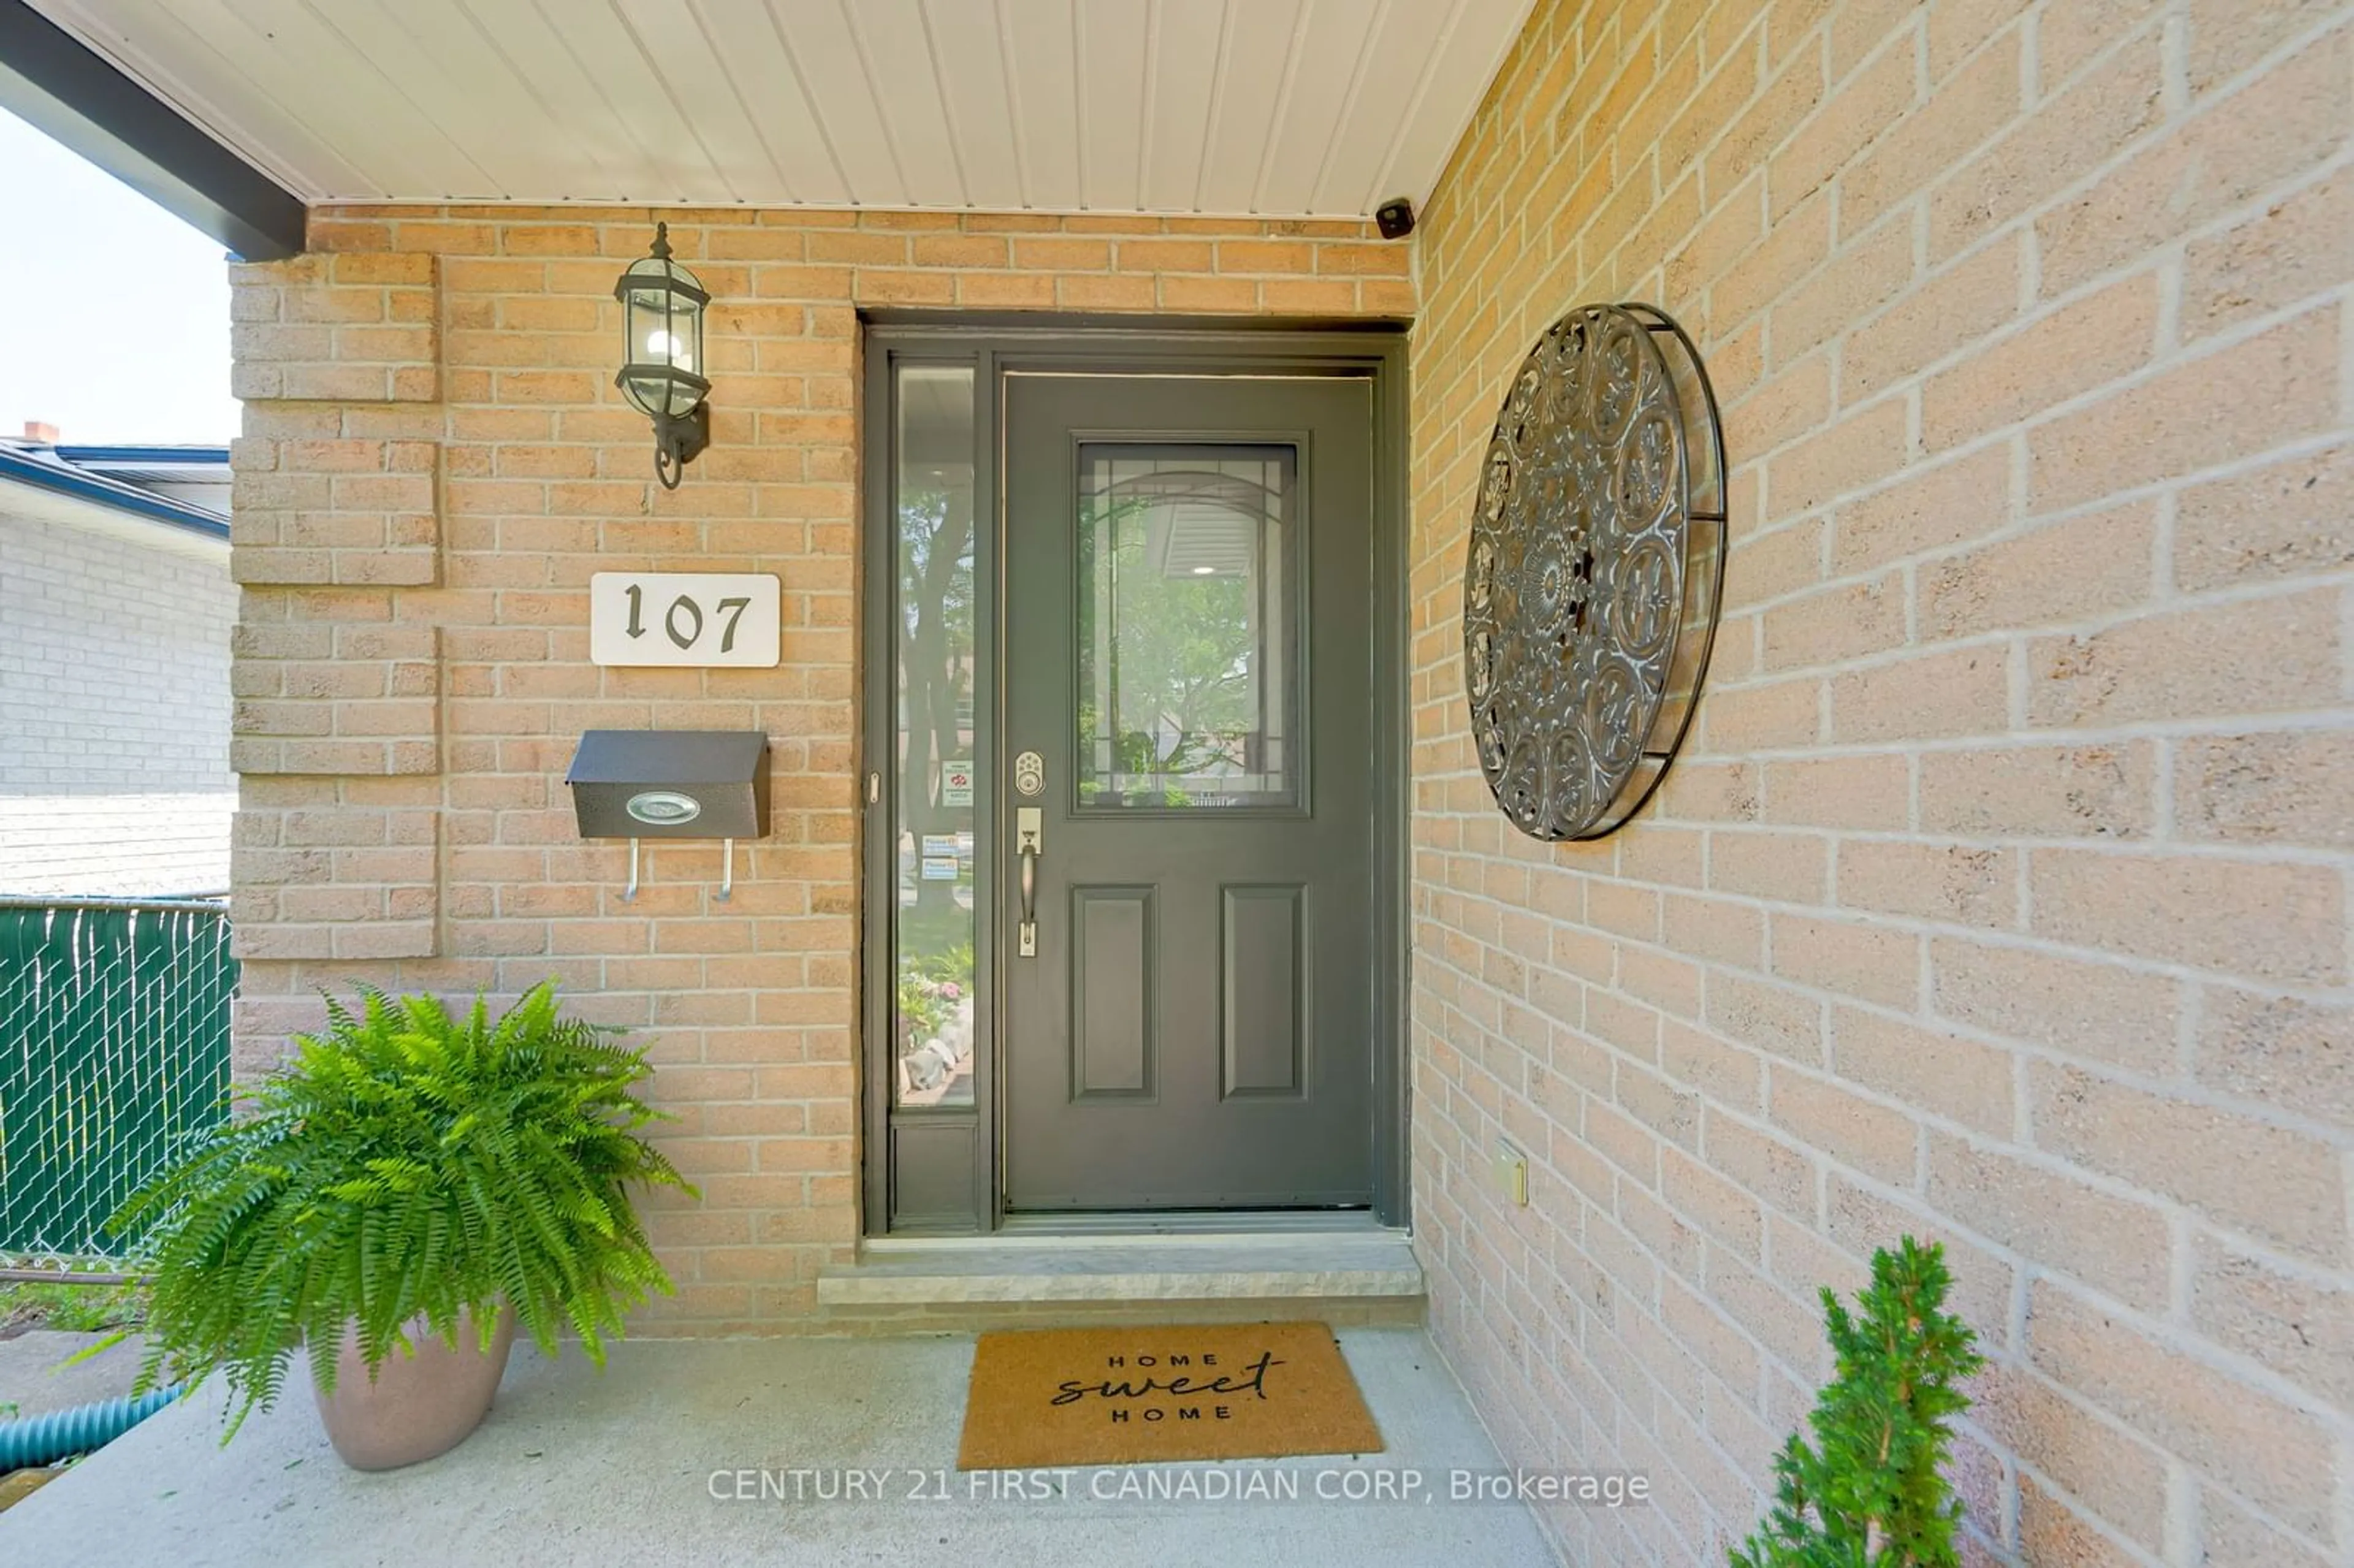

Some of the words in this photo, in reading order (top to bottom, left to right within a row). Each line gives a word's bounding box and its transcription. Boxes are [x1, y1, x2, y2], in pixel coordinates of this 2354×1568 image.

[624, 583, 752, 653] 107
[1050, 1351, 1287, 1406] sweet
[1108, 1354, 1217, 1368] HOME
[1112, 1406, 1231, 1423] HOME
